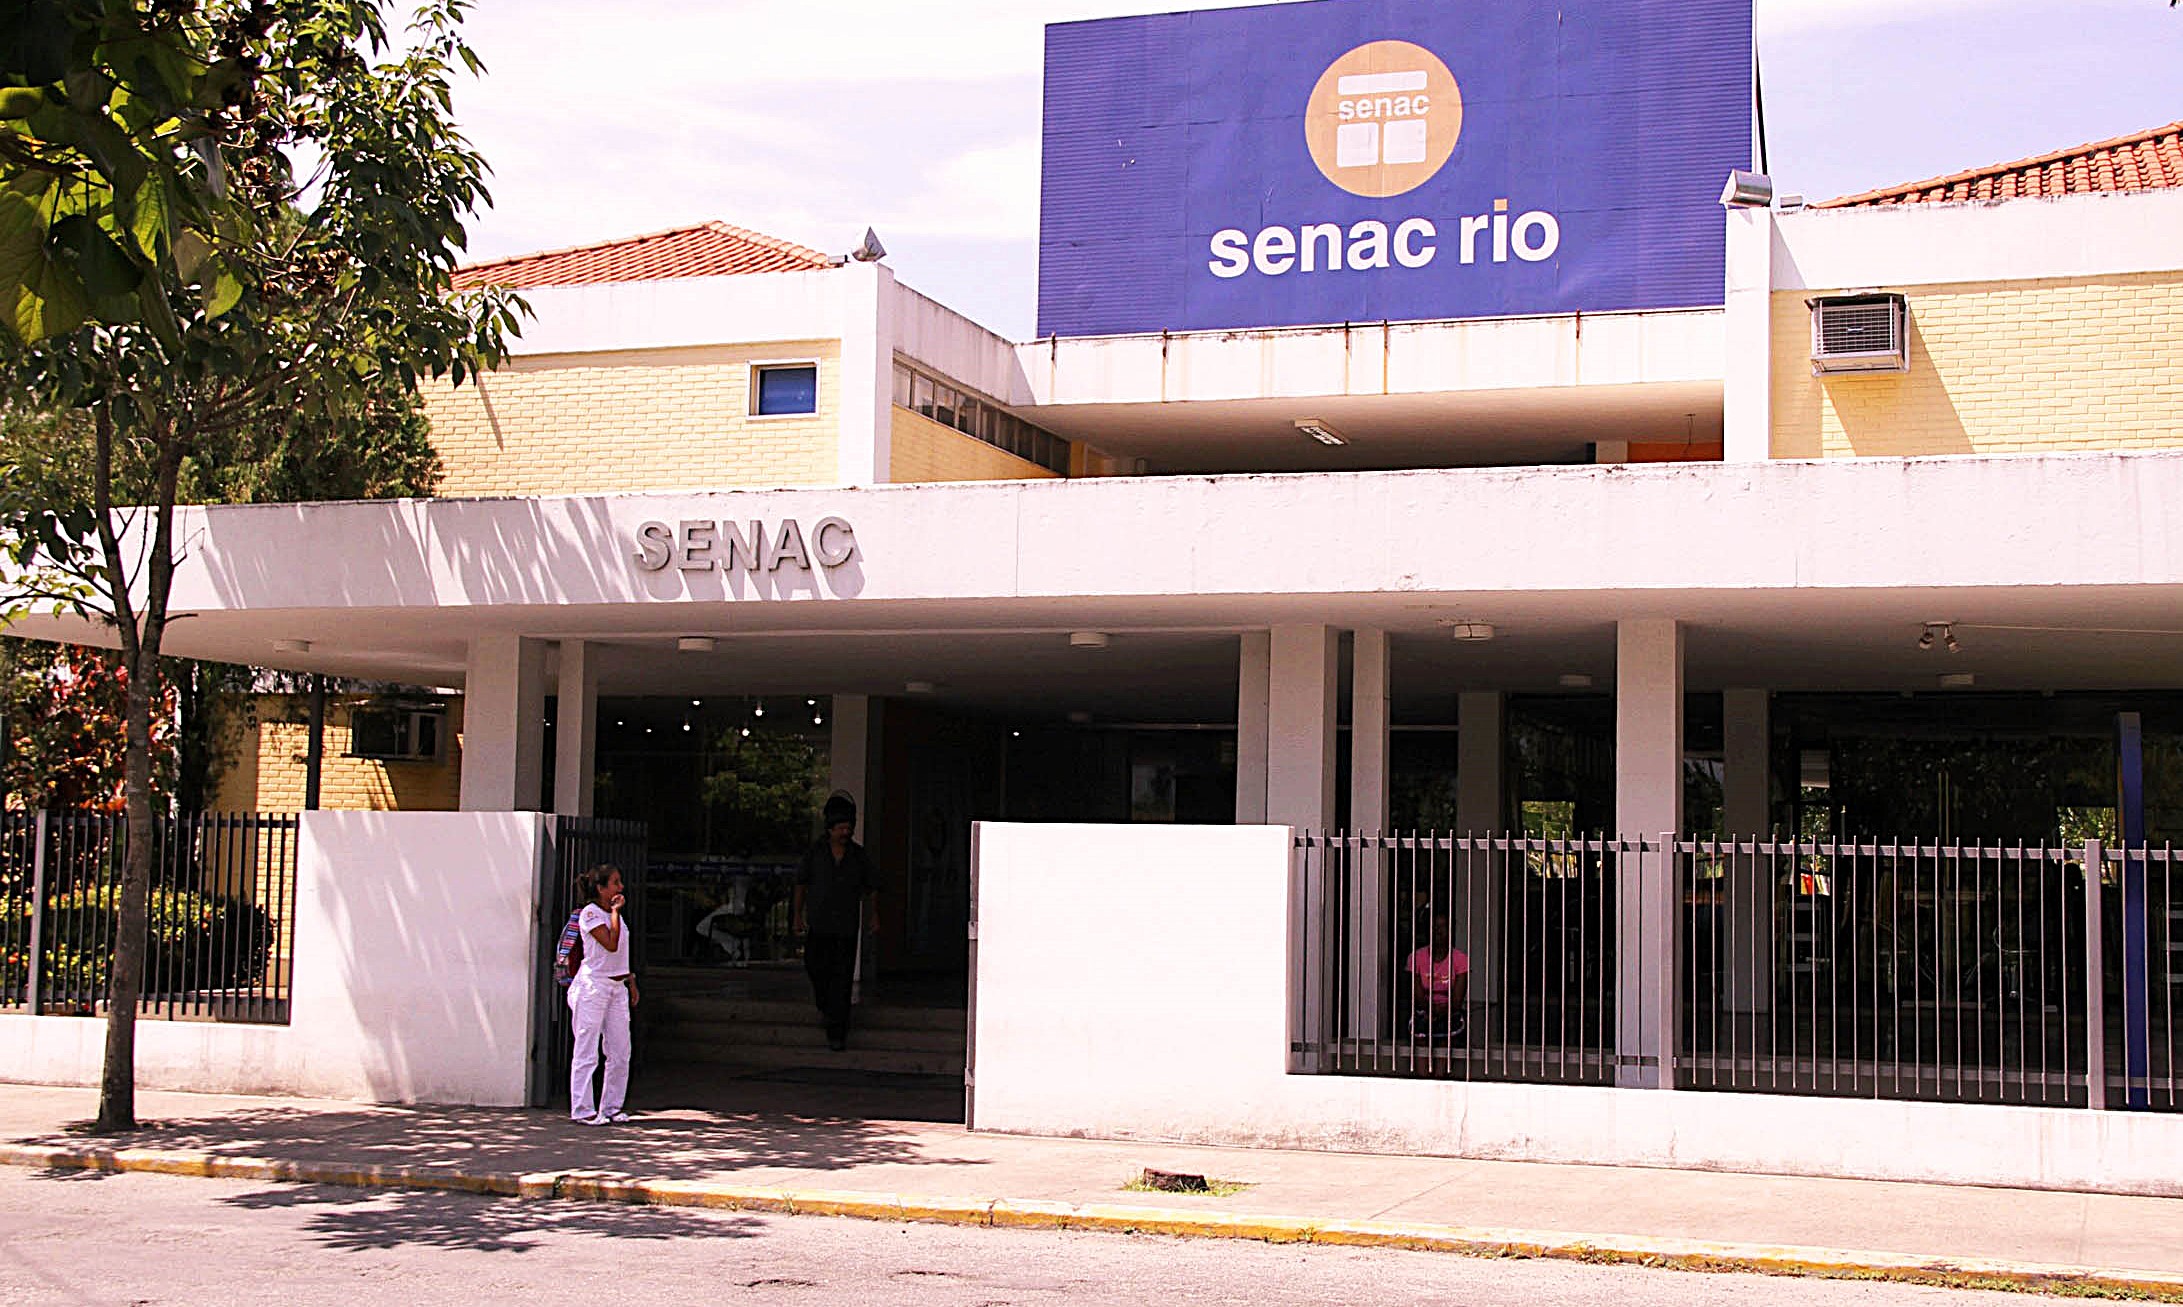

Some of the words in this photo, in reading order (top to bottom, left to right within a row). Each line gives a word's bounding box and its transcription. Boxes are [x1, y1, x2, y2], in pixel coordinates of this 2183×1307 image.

[1338, 95, 1430, 120] senac
[1208, 219, 1436, 278] senac
[1460, 199, 1560, 265] rio
[634, 516, 854, 571] SENAC
